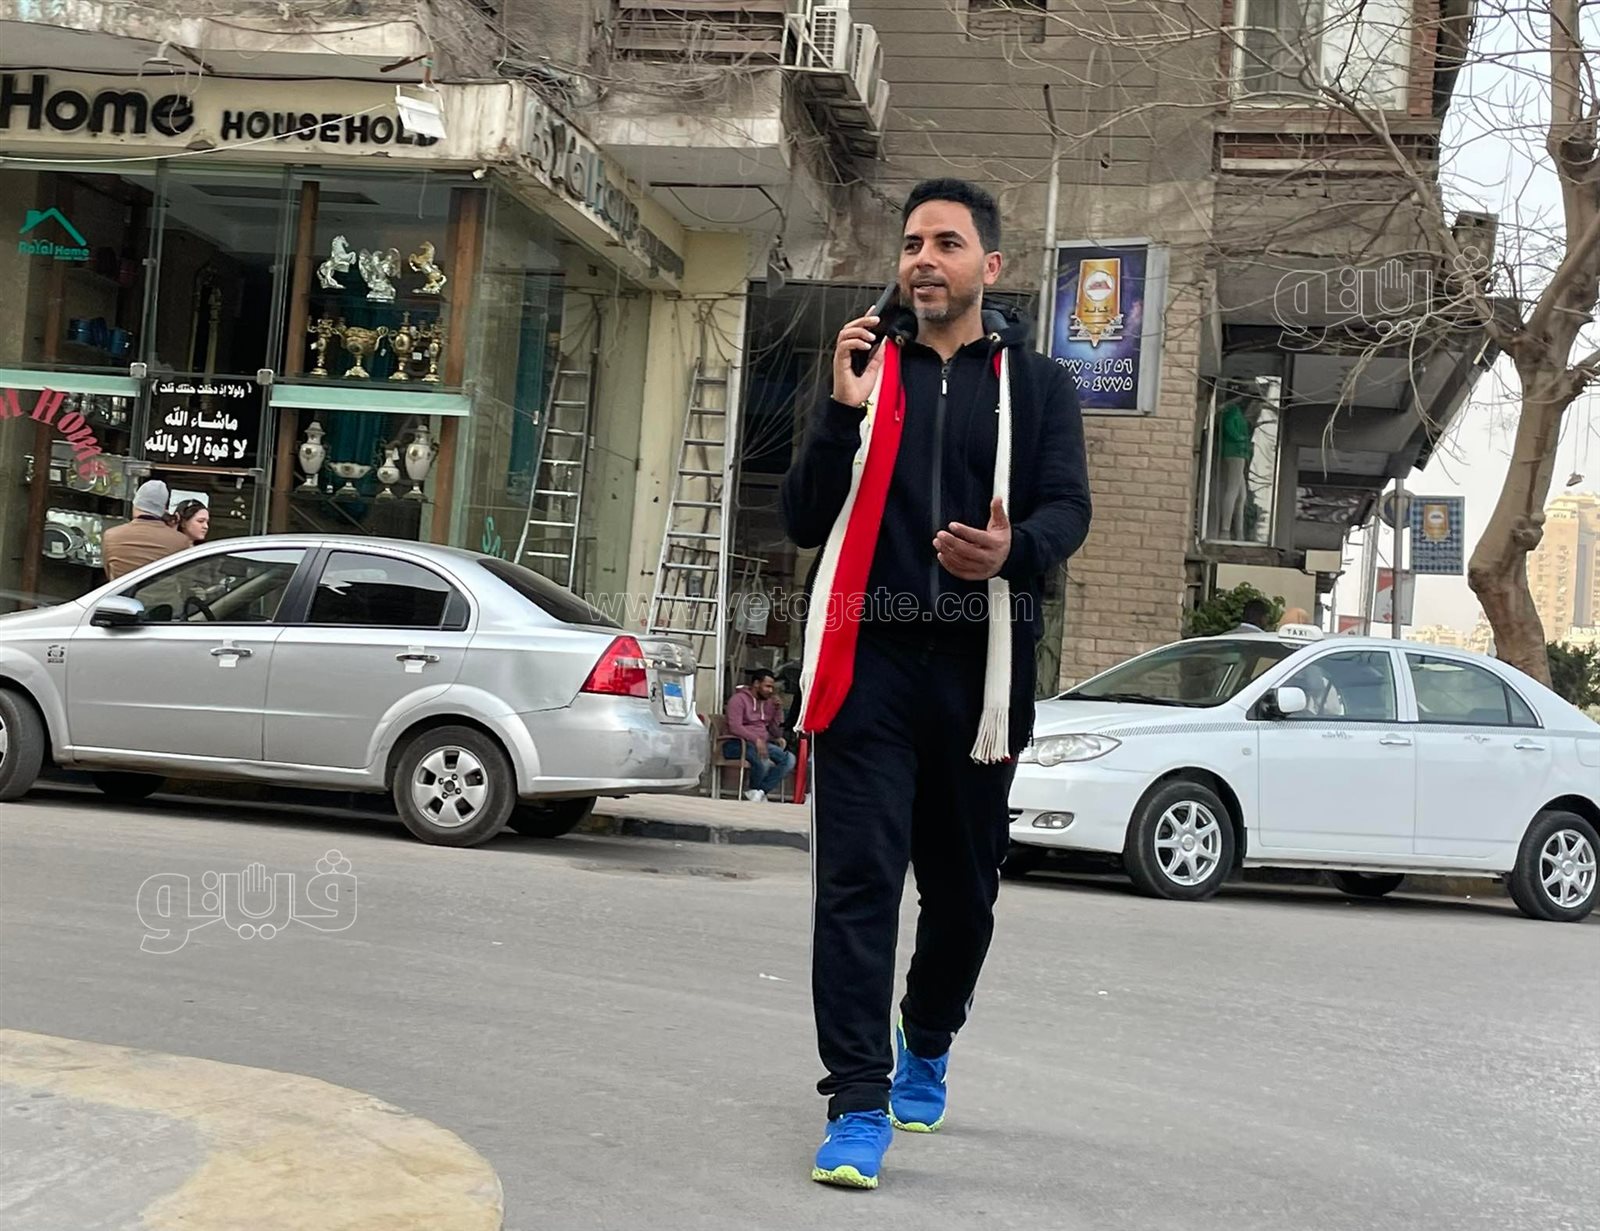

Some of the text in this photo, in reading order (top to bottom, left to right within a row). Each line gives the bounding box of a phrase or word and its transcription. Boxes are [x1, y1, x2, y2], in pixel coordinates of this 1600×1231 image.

[0, 74, 194, 137] Home
[54, 245, 90, 256] Home
[233, 438, 248, 459] لا
[1287, 628, 1308, 637] TAXI
